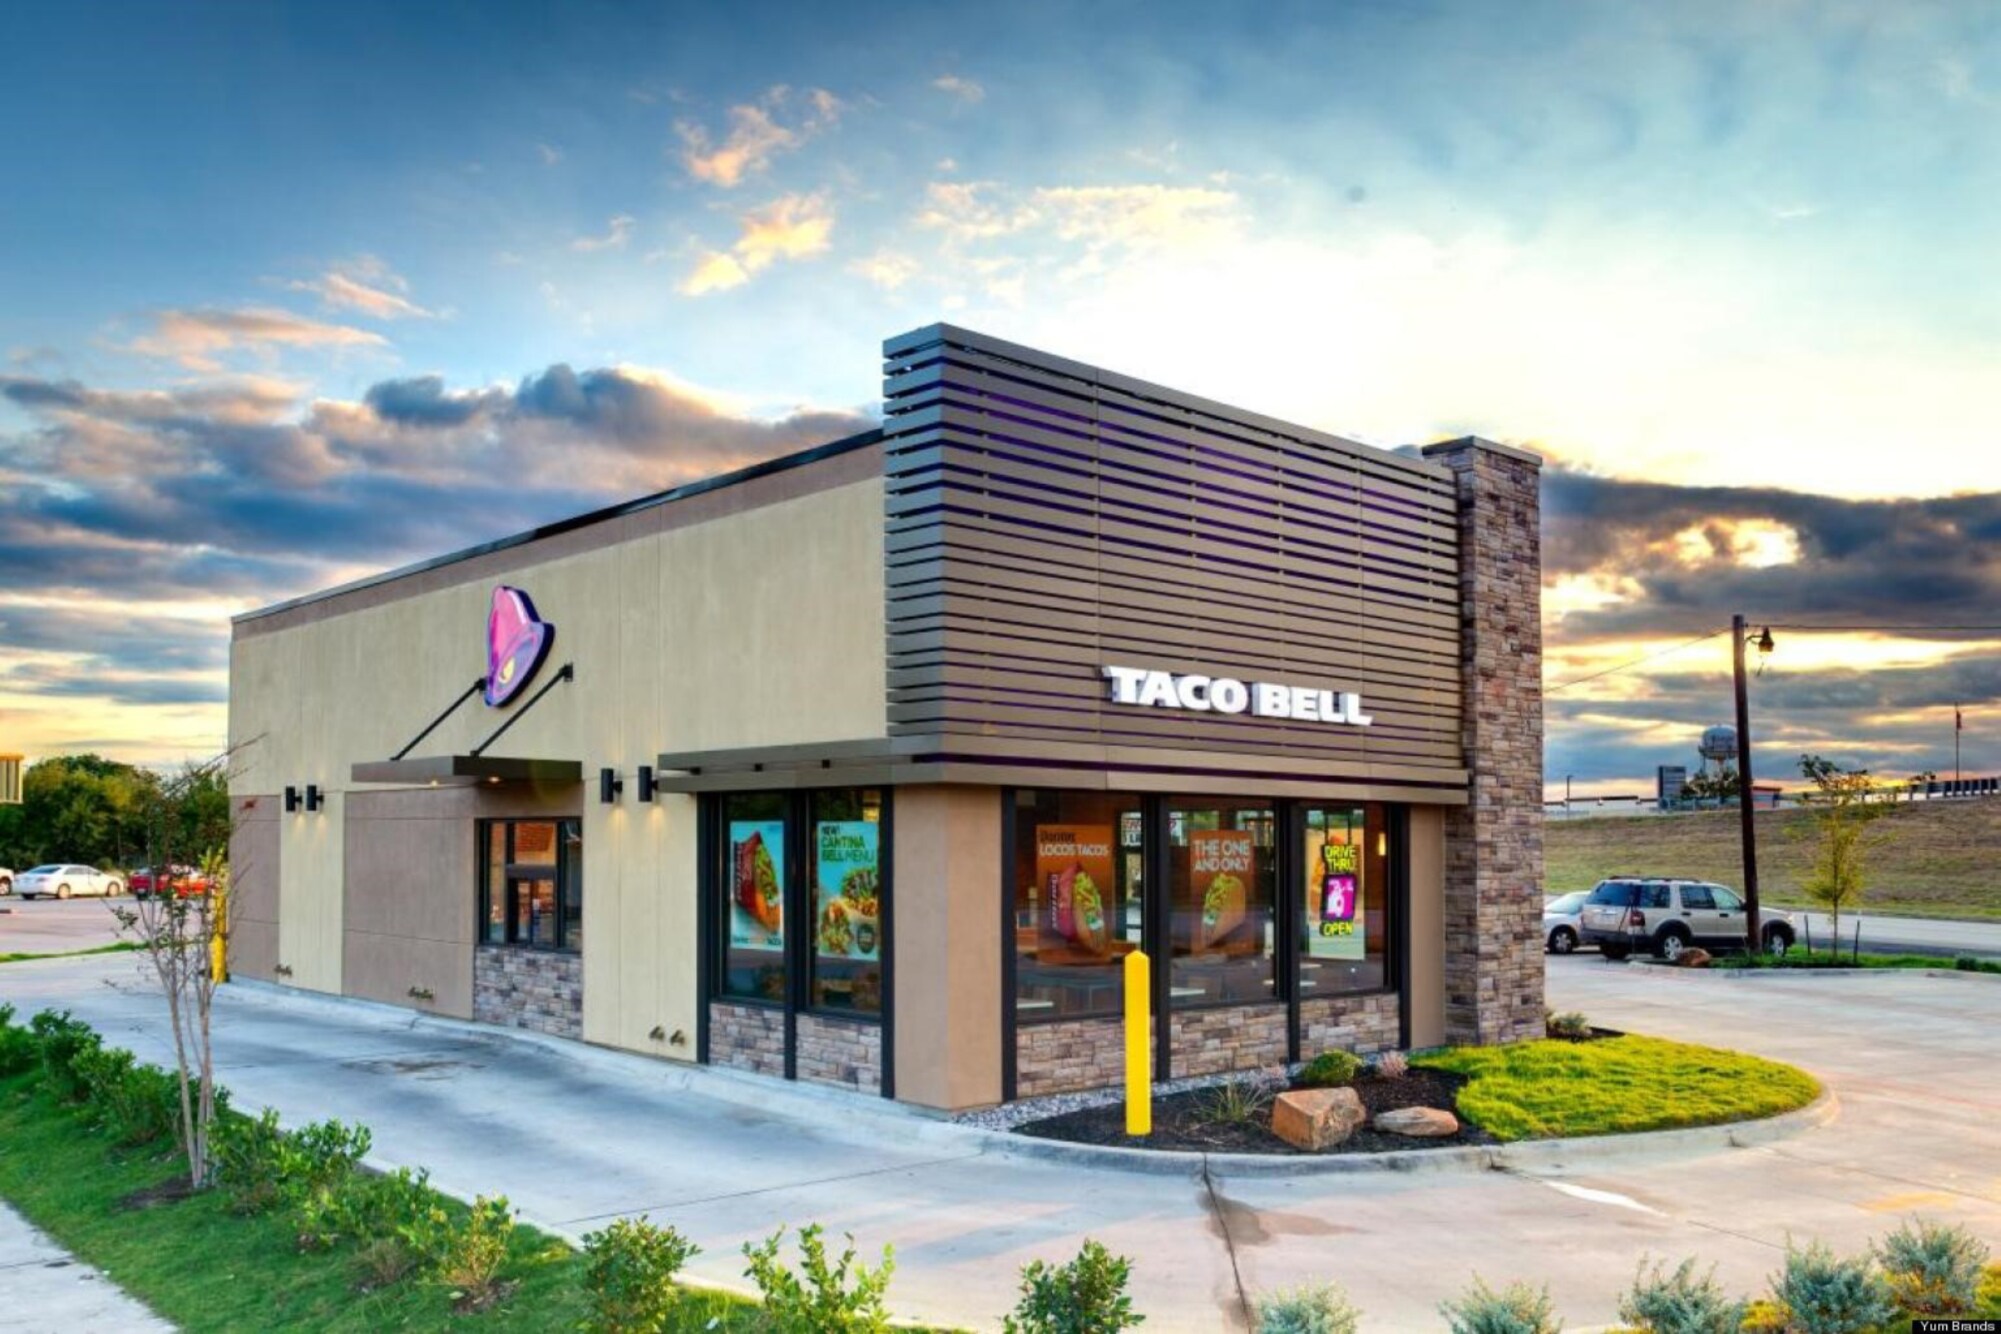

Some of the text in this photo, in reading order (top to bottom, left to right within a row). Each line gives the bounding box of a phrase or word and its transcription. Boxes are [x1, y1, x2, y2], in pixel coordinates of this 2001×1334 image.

[1102, 665, 1373, 726] TACO BELL
[821, 836, 866, 849] CANTINA
[1039, 843, 1109, 856] LOCOS TACOS
[1193, 839, 1250, 856] THE ONE
[1324, 845, 1356, 858] DRIVE
[1193, 857, 1250, 872] AND ONLY
[1327, 858, 1357, 873] THRU
[1322, 921, 1354, 937] OPEN
